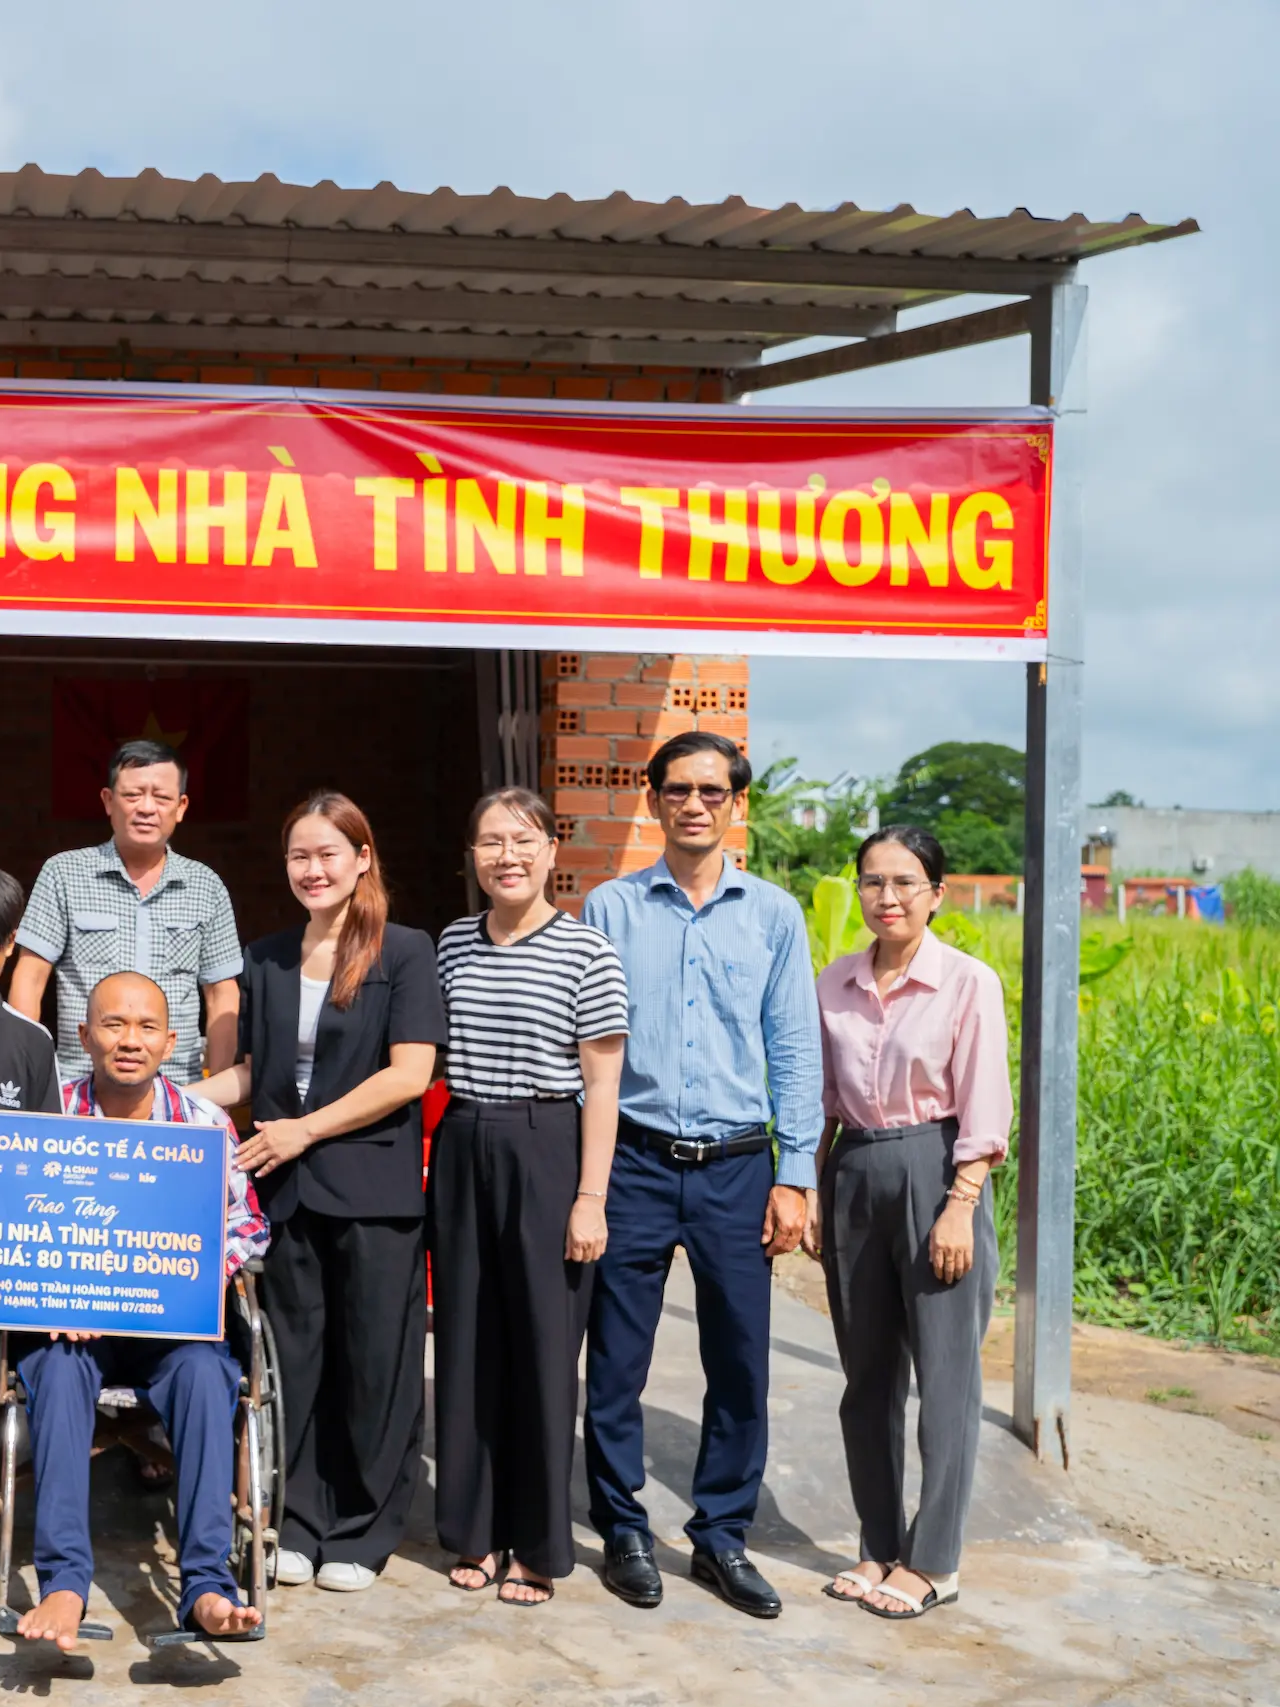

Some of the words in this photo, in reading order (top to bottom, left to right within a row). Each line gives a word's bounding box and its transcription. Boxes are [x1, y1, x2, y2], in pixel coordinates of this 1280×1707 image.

[115, 446, 318, 568] NHÀ
[354, 452, 585, 577] TÌNH
[620, 473, 1014, 591] THƯƠNG
[43, 1135, 100, 1157] QUỐC
[104, 1138, 129, 1159] TẾ
[132, 1140, 147, 1160] Á
[151, 1144, 204, 1164] CHÂU
[25, 1193, 65, 1214] Trao
[72, 1196, 120, 1226] Tặng
[7, 1220, 54, 1243] NHÀ
[58, 1222, 109, 1247] TÌNH
[113, 1229, 202, 1252] THƯƠNG
[37, 1249, 63, 1269] 80
[67, 1249, 128, 1276] TRIỆU
[132, 1251, 199, 1281] ĐỒNG)
[15, 1279, 39, 1292] ÔNG
[41, 1280, 71, 1294] TRẦN
[72, 1283, 111, 1296] HOÀNG
[113, 1286, 159, 1299] PHƯƠNG
[69, 1297, 90, 1310] TÂY
[92, 1300, 120, 1312] NINH
[121, 1301, 165, 1314] 07/2026
